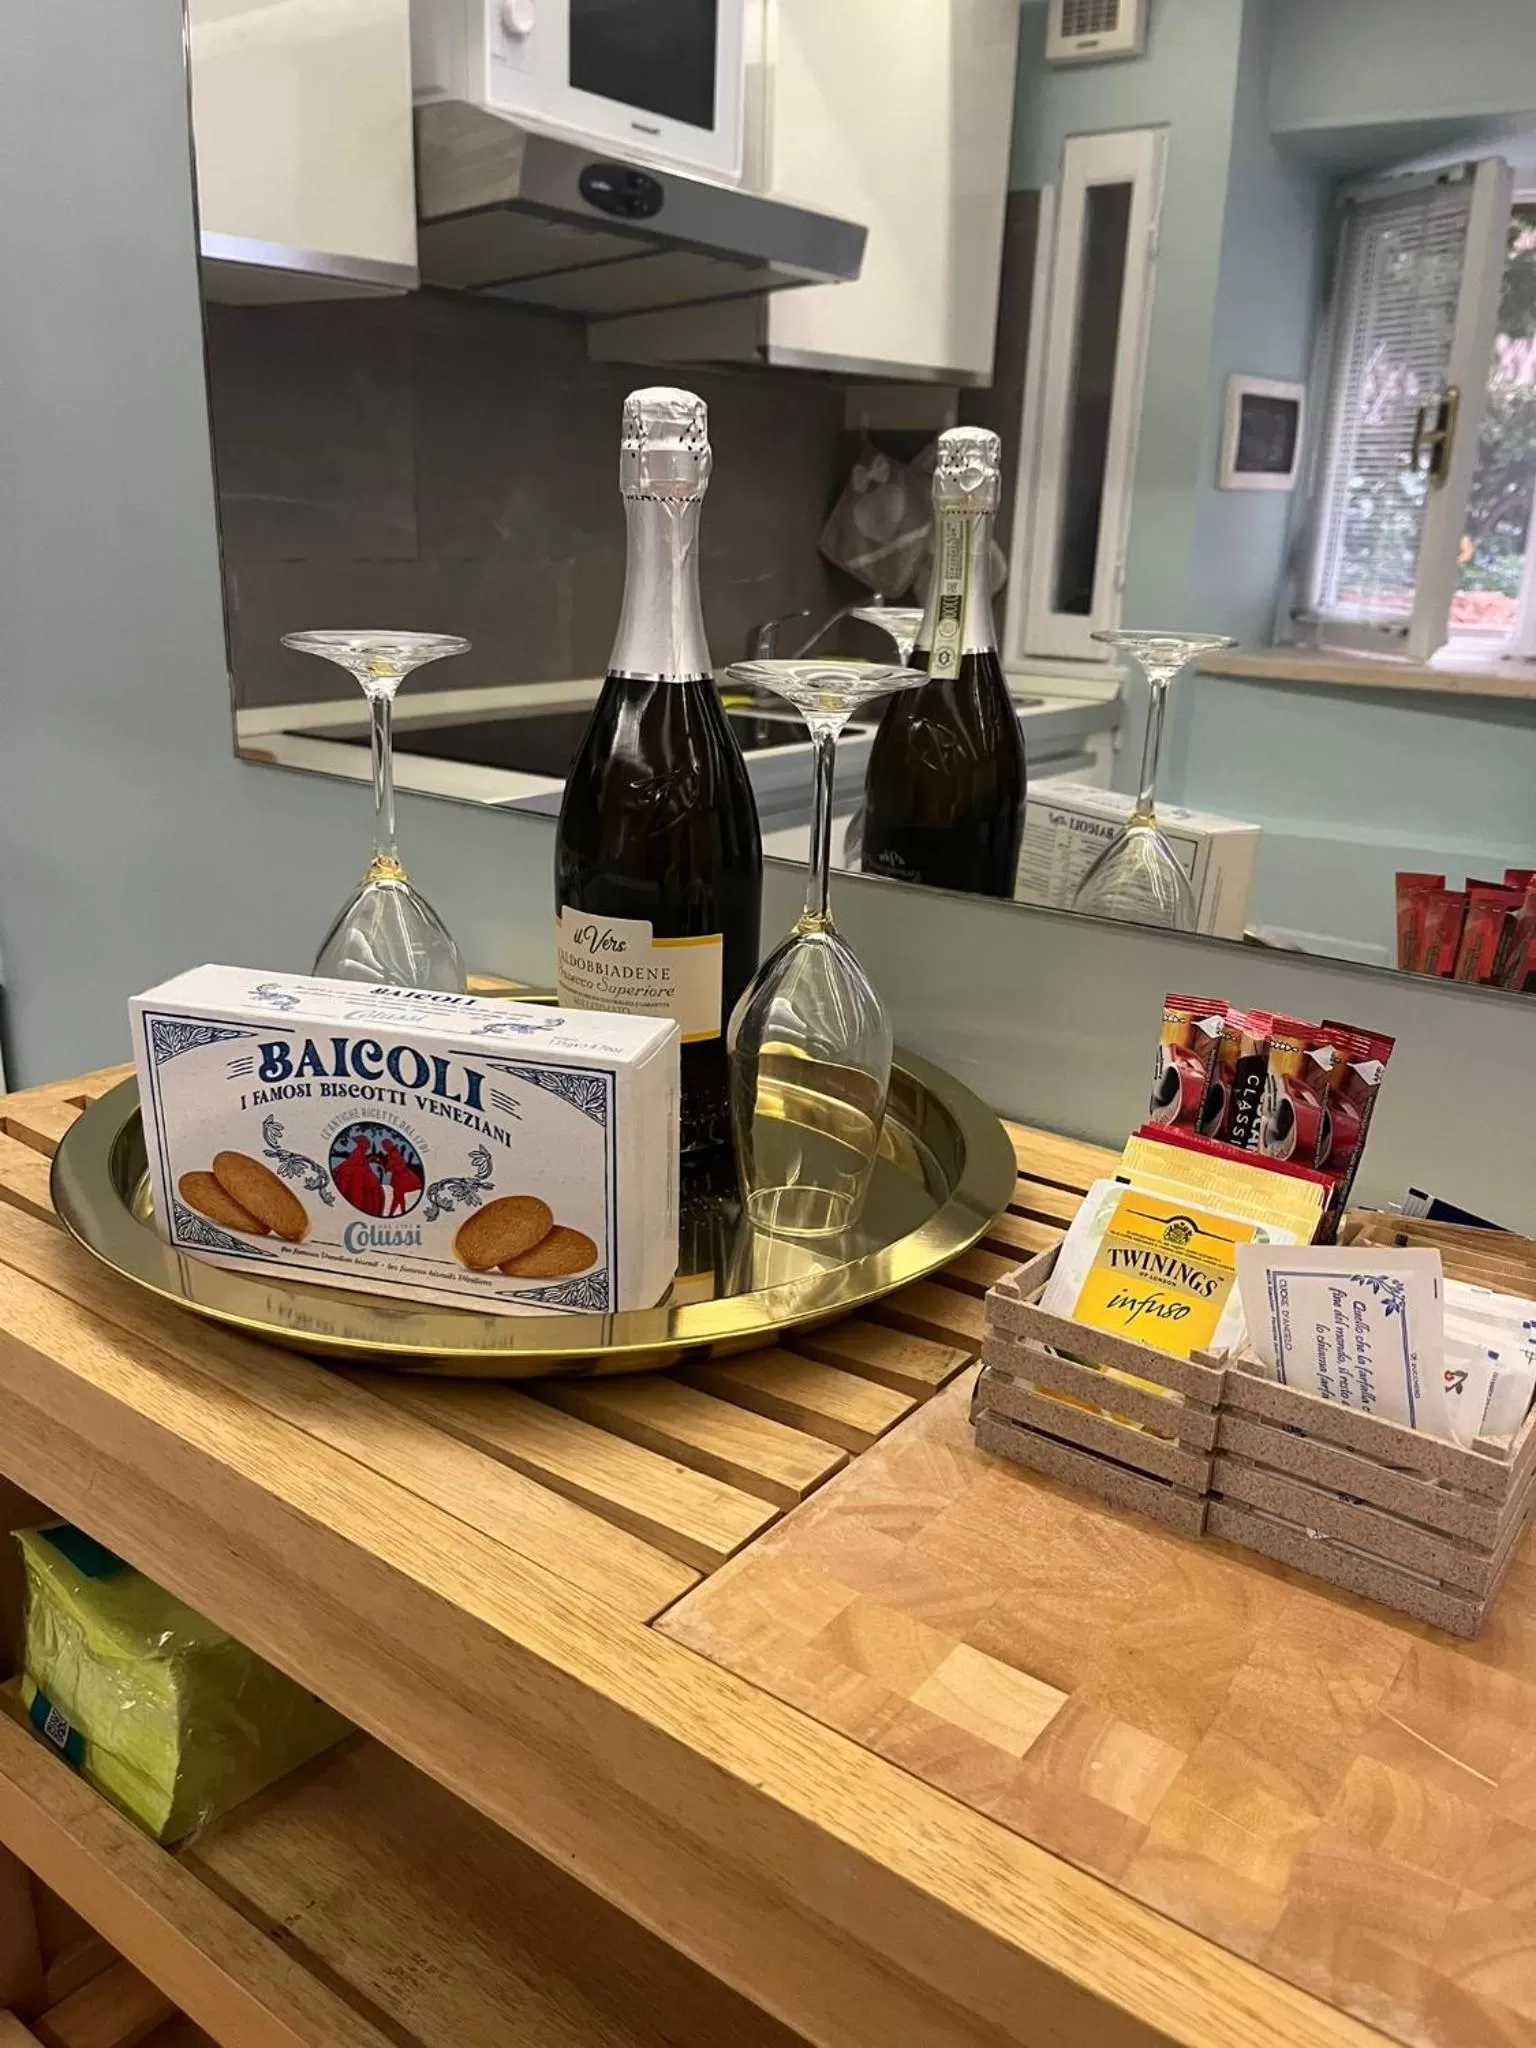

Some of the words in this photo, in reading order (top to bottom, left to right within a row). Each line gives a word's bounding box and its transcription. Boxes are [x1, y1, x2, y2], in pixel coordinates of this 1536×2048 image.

[583, 924, 628, 954] Vers
[596, 976, 677, 999] Superiore
[257, 1037, 486, 1112] BAICOLI
[240, 1095, 247, 1111] I
[252, 1083, 313, 1106] FAMOSI
[320, 1083, 406, 1106] BISCOTTI
[414, 1094, 512, 1148] VENEZIANI
[1230, 1075, 1260, 1146] CLASSI
[344, 1221, 422, 1254] Colussi
[1107, 1248, 1218, 1298] TWININGS
[1149, 1274, 1177, 1287] LONDON
[1106, 1288, 1191, 1325] infuso
[1279, 1278, 1290, 1307] CUORE
[1329, 1287, 1348, 1308] fine
[1282, 1309, 1293, 1351] D'ANGELO
[1315, 1322, 1331, 1333] lo
[1334, 1309, 1350, 1326] del
[1353, 1300, 1371, 1334] Quello
[1316, 1335, 1332, 1372] chiama
[1355, 1335, 1371, 1353] che
[1338, 1366, 1353, 1375] il
[1358, 1355, 1372, 1365] la
[1316, 1372, 1336, 1399] farfa
[1340, 1375, 1353, 1399] resto
[1355, 1366, 1376, 1404] farfalla
